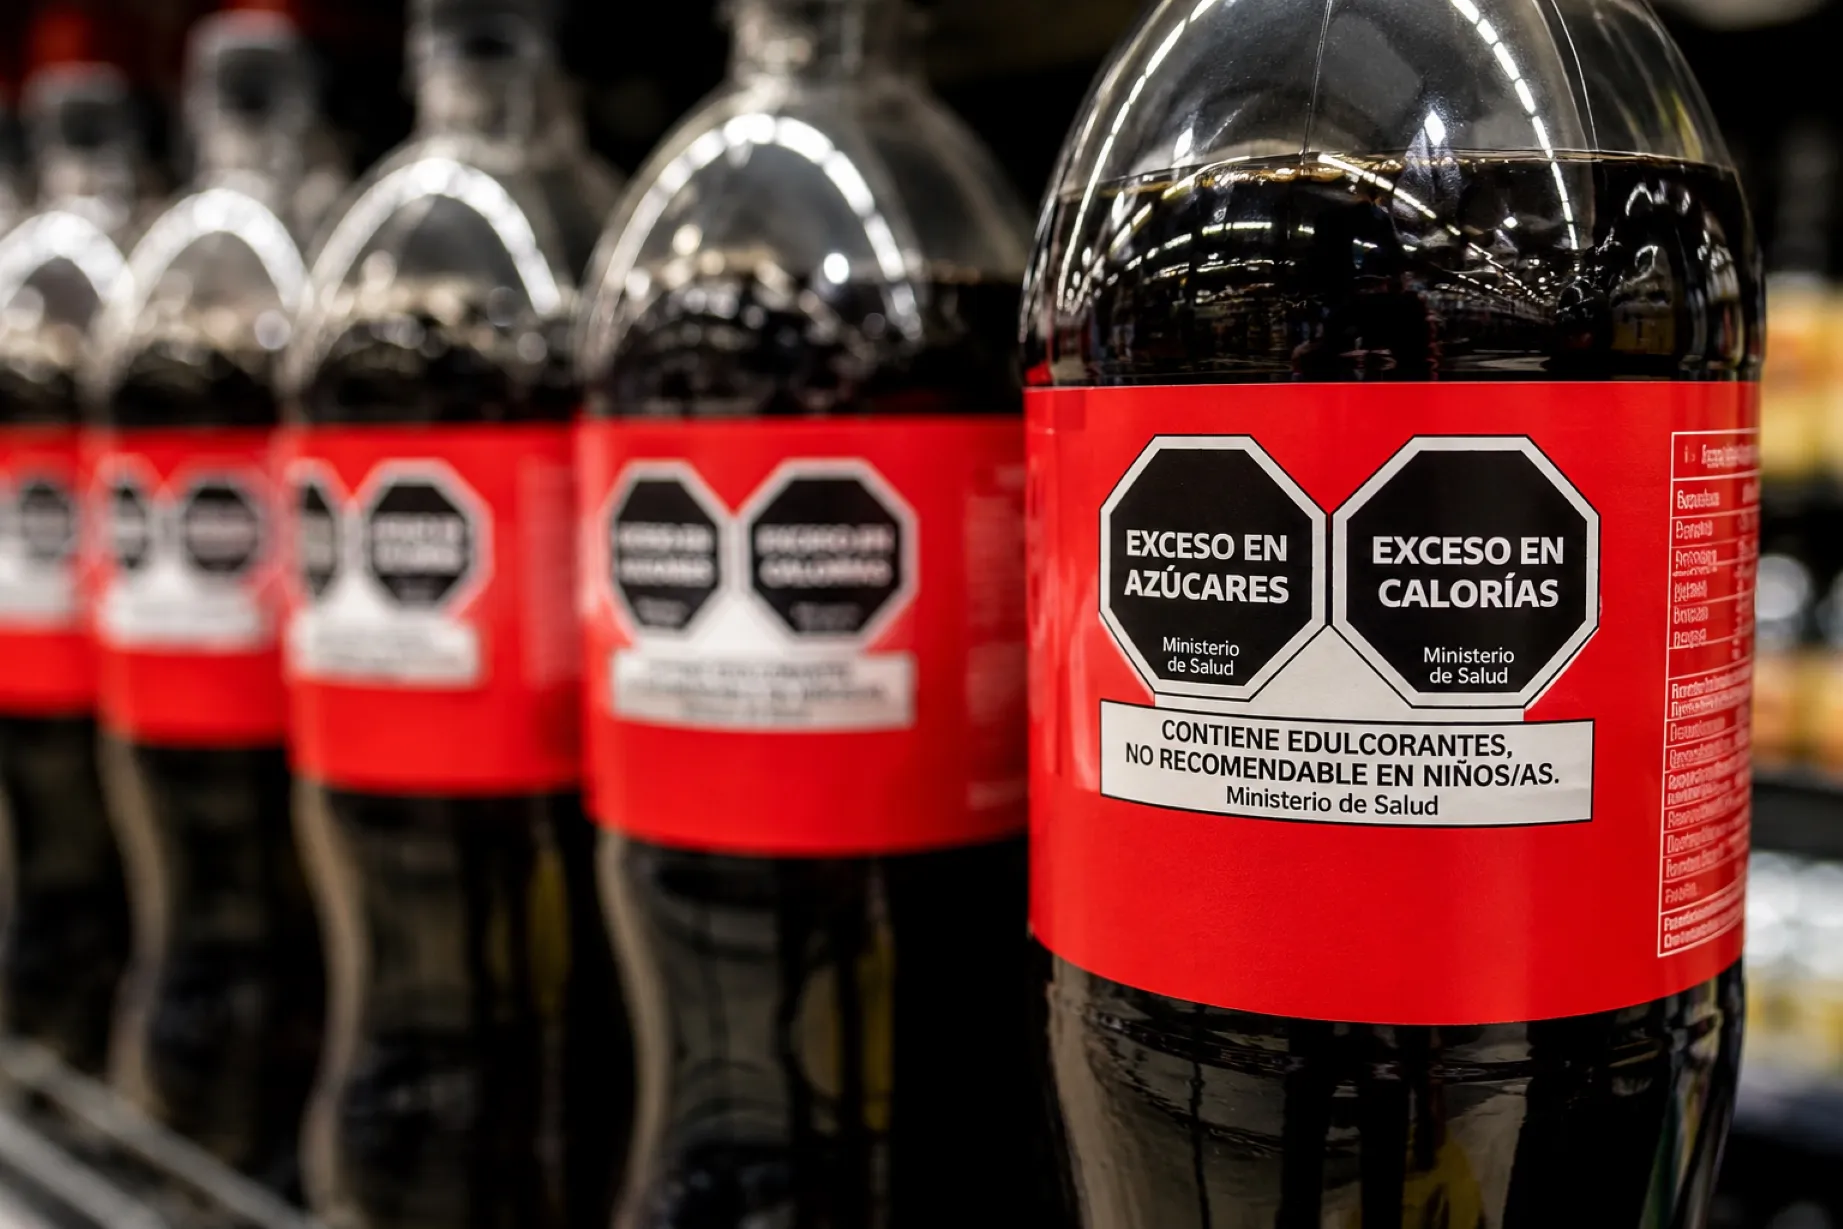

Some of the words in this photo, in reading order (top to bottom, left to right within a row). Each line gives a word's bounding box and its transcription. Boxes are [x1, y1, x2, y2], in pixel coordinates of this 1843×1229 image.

[1126, 528, 1234, 560] EXCESO
[1244, 534, 1288, 562] EN
[1372, 536, 1510, 565] EXCESO
[1521, 536, 1564, 564] EN
[1124, 565, 1289, 603] AZÚCARES
[1378, 572, 1559, 608] CALORÍAS
[1163, 637, 1239, 657] Ministerio
[1424, 647, 1515, 664] Ministerio
[1167, 657, 1186, 673] de
[1190, 658, 1234, 676] Salud
[1430, 666, 1451, 683] de
[1458, 667, 1508, 684] Salud
[1162, 720, 1279, 750] CONTIENE
[1288, 729, 1513, 758] EDULCORANTES,
[1126, 744, 1153, 765] NO
[1160, 748, 1367, 785] RECOMENDABLE
[1376, 764, 1415, 786] EN
[1423, 760, 1560, 788] NIÑOS/AS.
[1227, 786, 1331, 813] Ministerio
[1339, 794, 1367, 813] de
[1374, 795, 1439, 816] Salud
